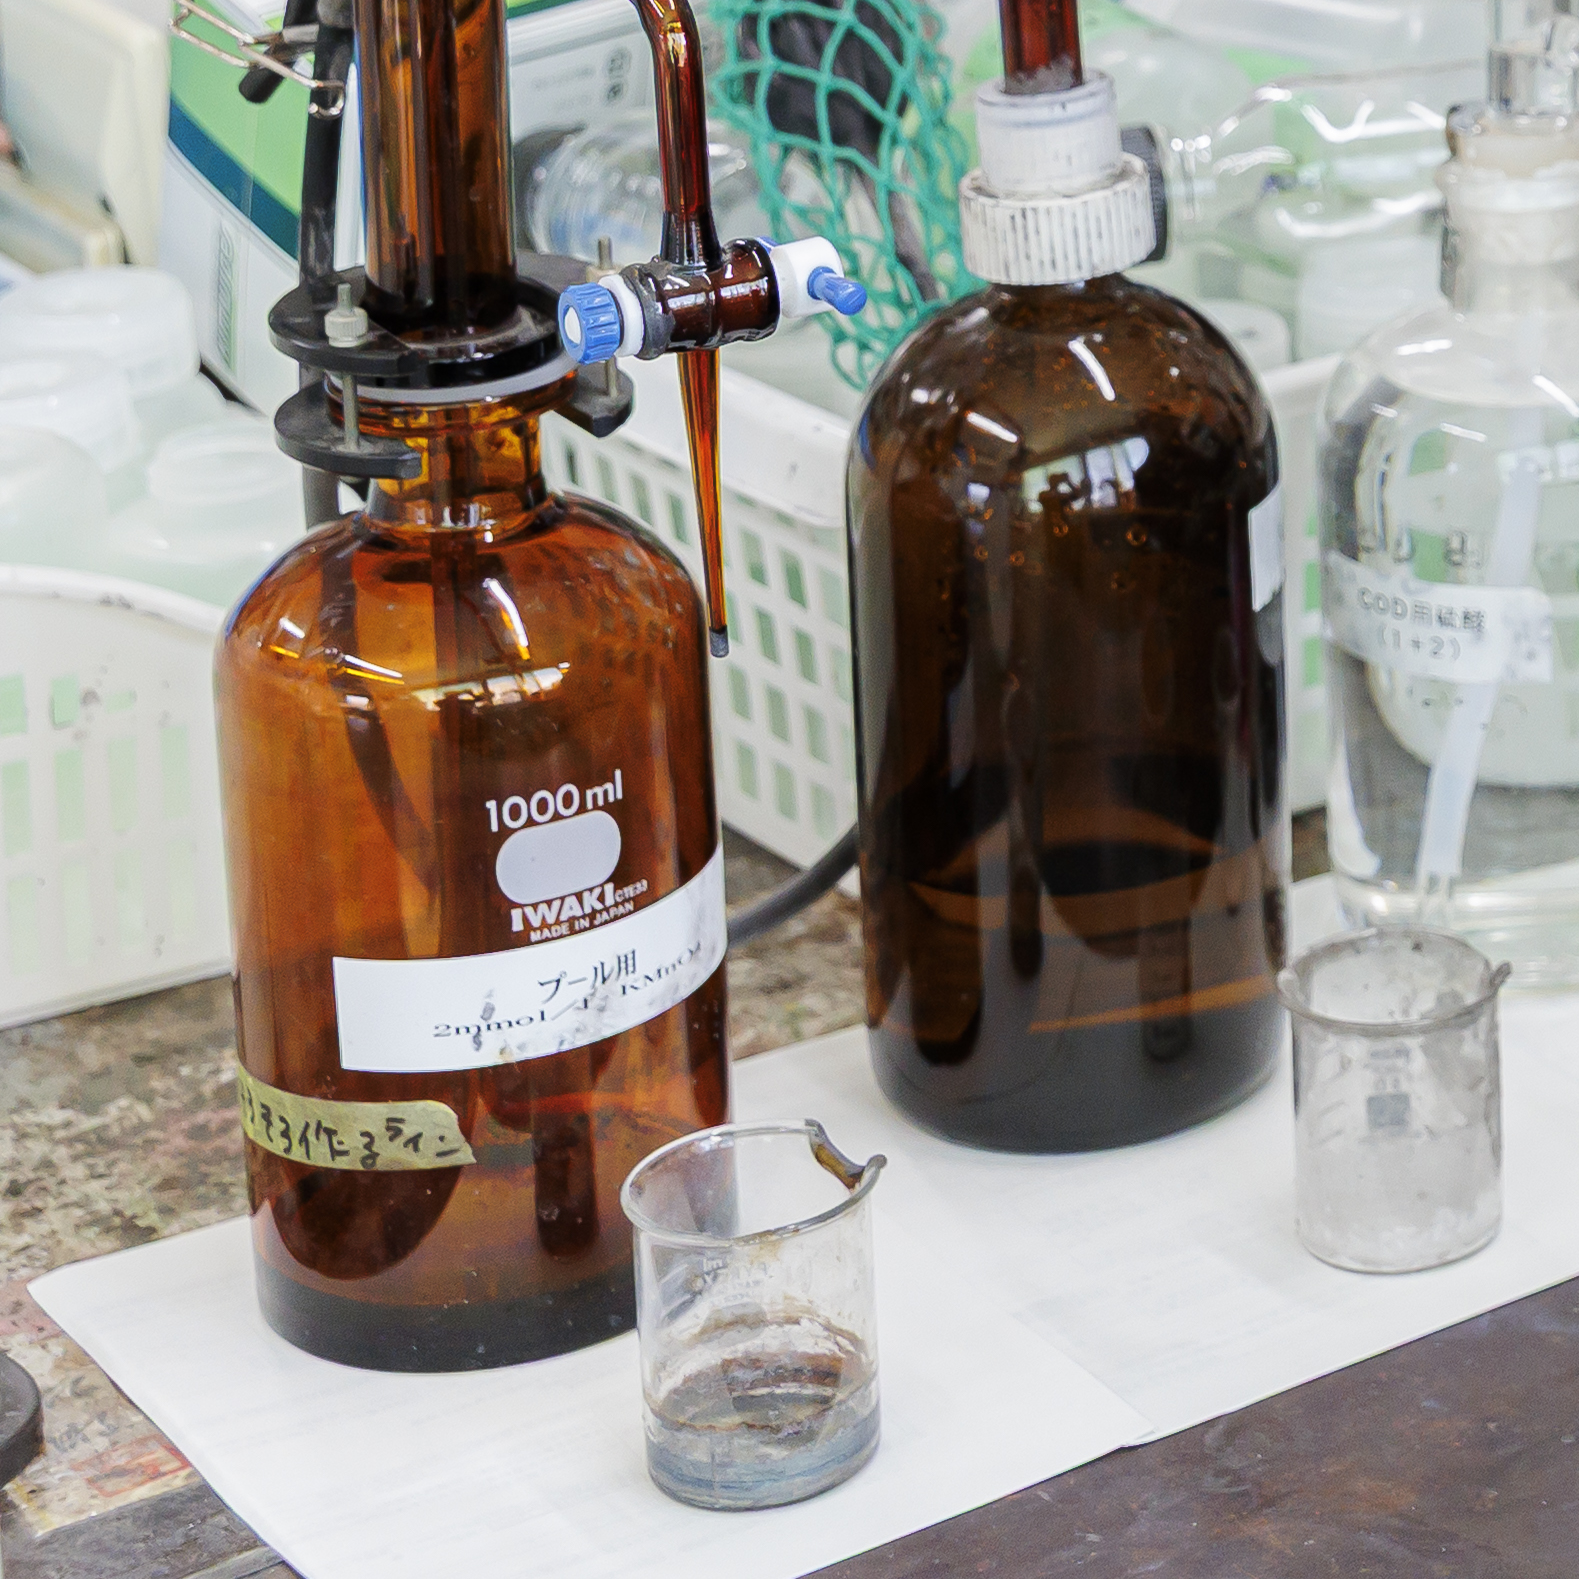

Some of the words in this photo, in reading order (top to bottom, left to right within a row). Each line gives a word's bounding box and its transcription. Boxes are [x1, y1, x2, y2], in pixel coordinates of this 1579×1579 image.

[485, 783, 580, 833] 1000
[585, 768, 623, 810] ml
[510, 881, 615, 933] IWAKI
[529, 922, 570, 943] MADE
[574, 916, 590, 931] IN
[594, 900, 634, 926] JAPAN
[537, 948, 637, 1004] プール用
